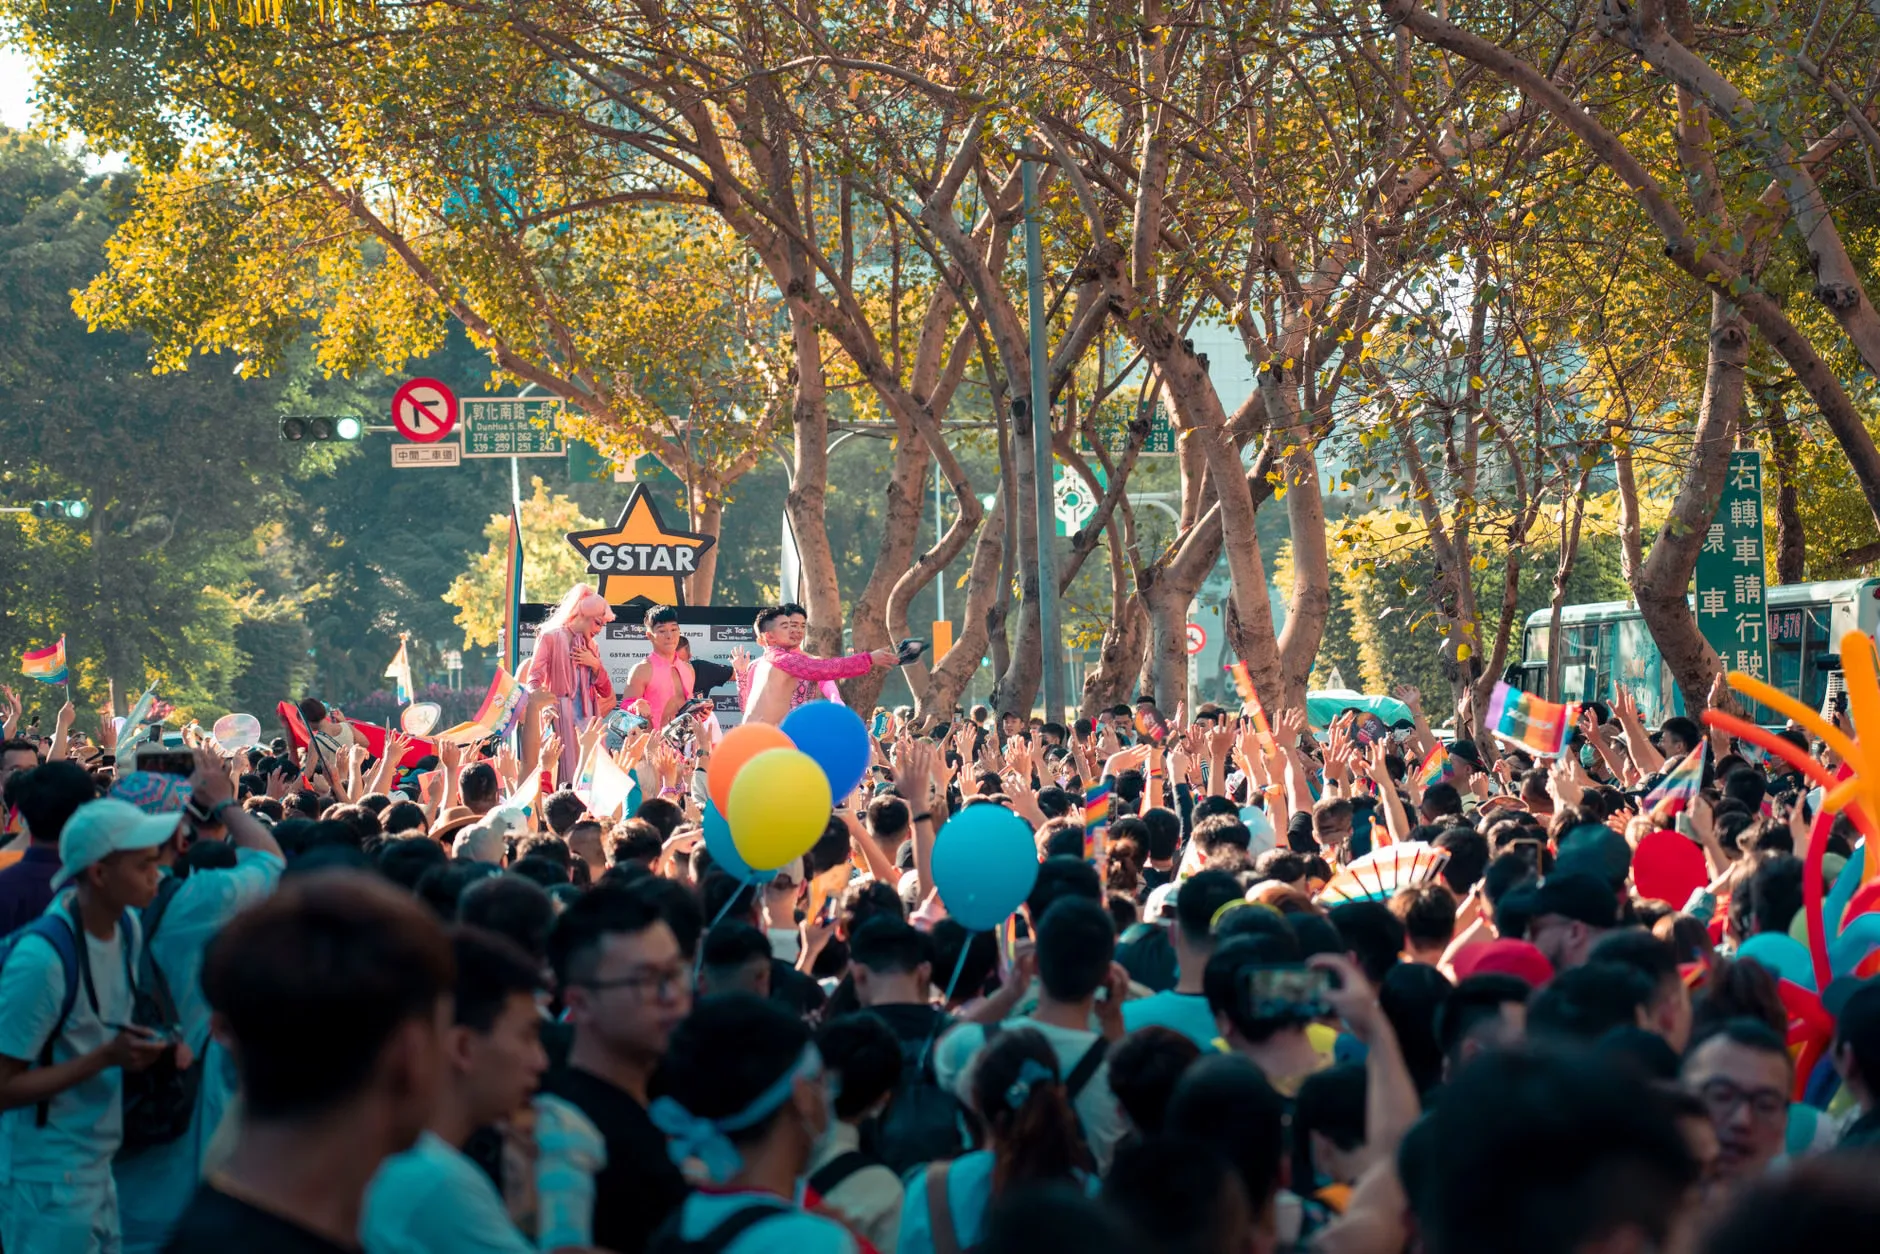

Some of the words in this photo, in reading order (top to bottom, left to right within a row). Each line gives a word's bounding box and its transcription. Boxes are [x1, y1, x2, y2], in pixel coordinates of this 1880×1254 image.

[589, 545, 695, 571] GSTAR
[1730, 459, 1764, 679] 右轉車請行駛
